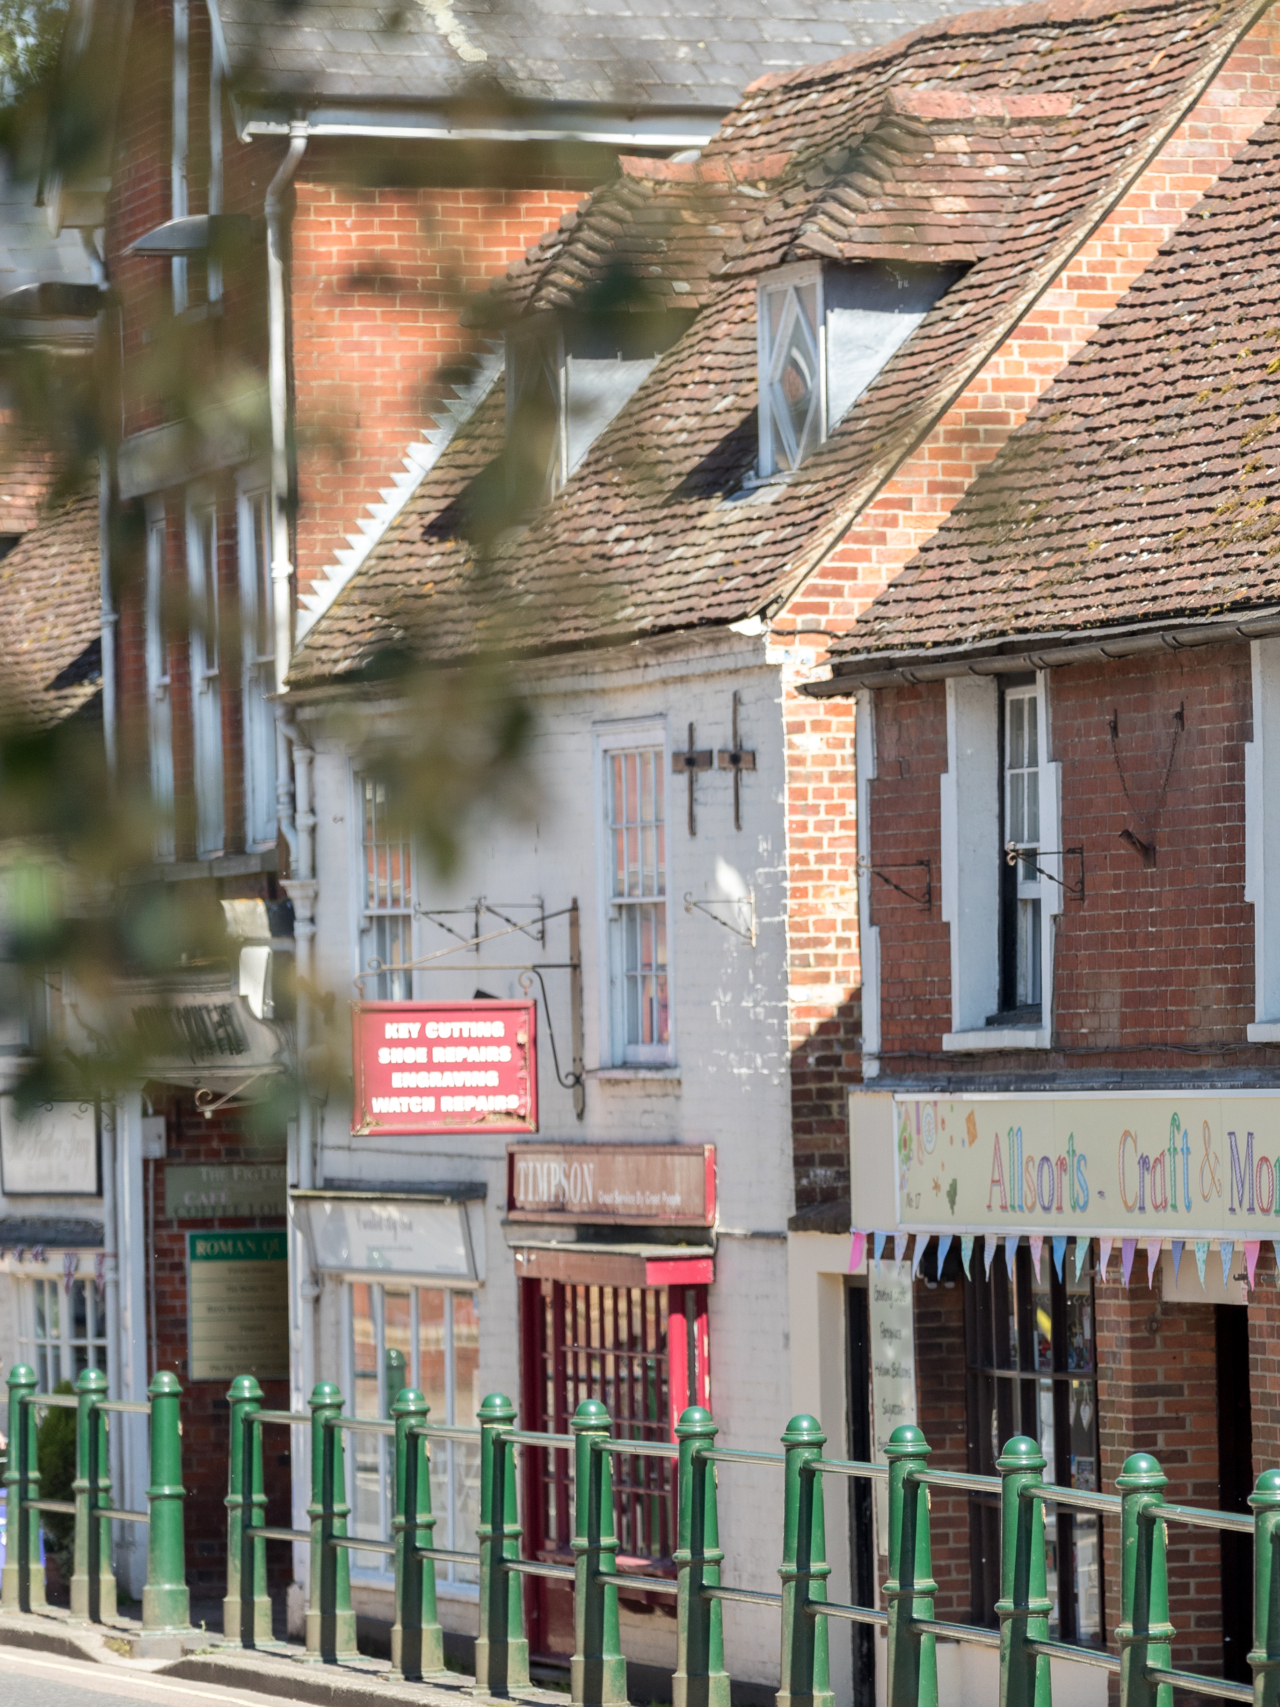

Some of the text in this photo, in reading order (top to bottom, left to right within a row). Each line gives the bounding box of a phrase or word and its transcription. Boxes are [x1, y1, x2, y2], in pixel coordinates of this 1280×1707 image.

[385, 1021, 505, 1039] KEY CUTTING
[378, 1045, 512, 1064] SHOE REPAIRS
[391, 1070, 499, 1088] ENGRAVING
[371, 1094, 520, 1113] WATCH REPAIRS
[986, 1125, 1089, 1214] Allsorts
[1118, 1111, 1193, 1214] Craft
[1199, 1119, 1223, 1204] &
[518, 1161, 594, 1204] TIMPSON
[195, 1238, 257, 1257] ROMAN
